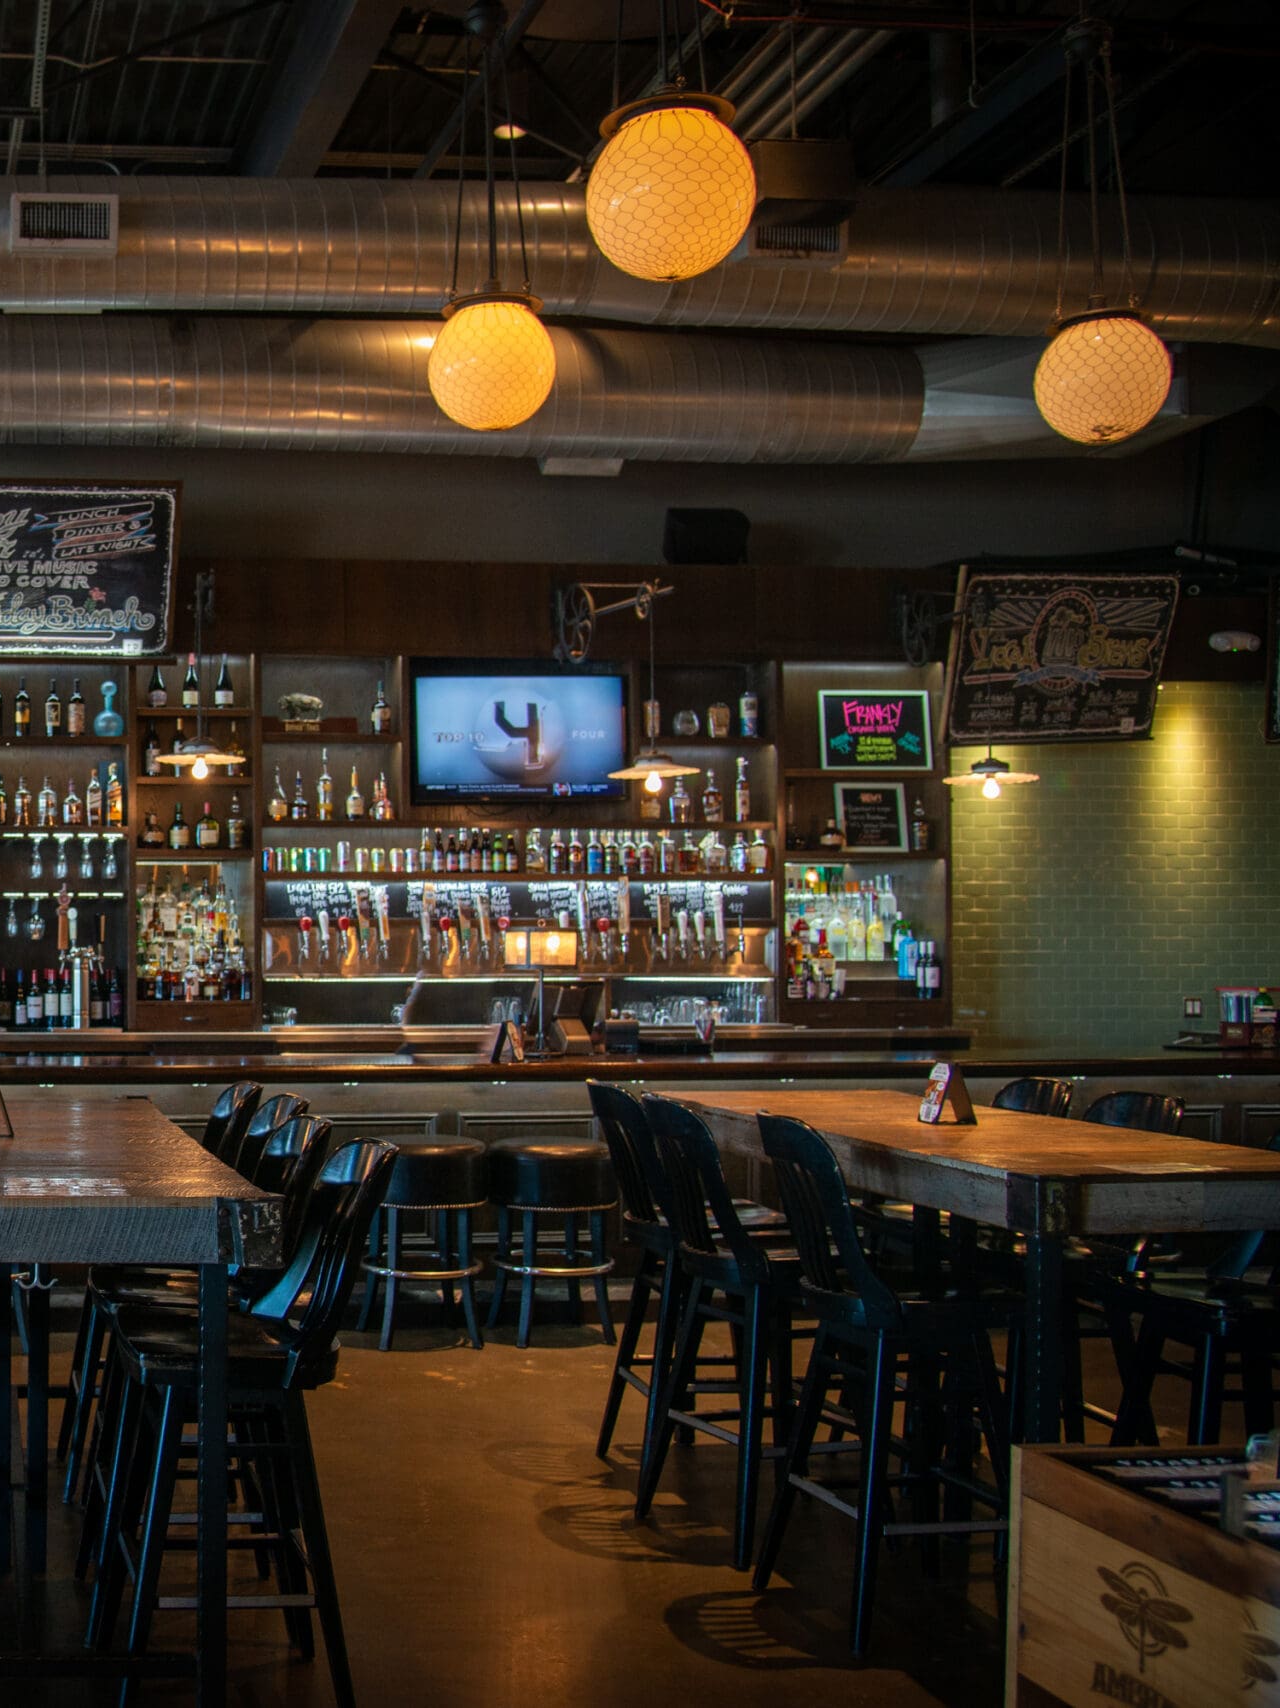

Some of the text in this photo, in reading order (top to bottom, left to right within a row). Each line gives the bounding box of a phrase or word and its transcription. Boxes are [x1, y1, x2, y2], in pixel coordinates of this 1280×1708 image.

[57, 508, 120, 523] LUNCH
[63, 523, 126, 539] DINNER
[60, 538, 143, 558] LATE NIGHT
[31, 560, 98, 576] MUSIC
[15, 575, 91, 590] COVER
[44, 594, 156, 630] Brunch
[1076, 623, 1150, 669] Brews
[433, 732, 464, 744] TOP
[494, 700, 544, 770] 4
[571, 729, 606, 740] FOUR
